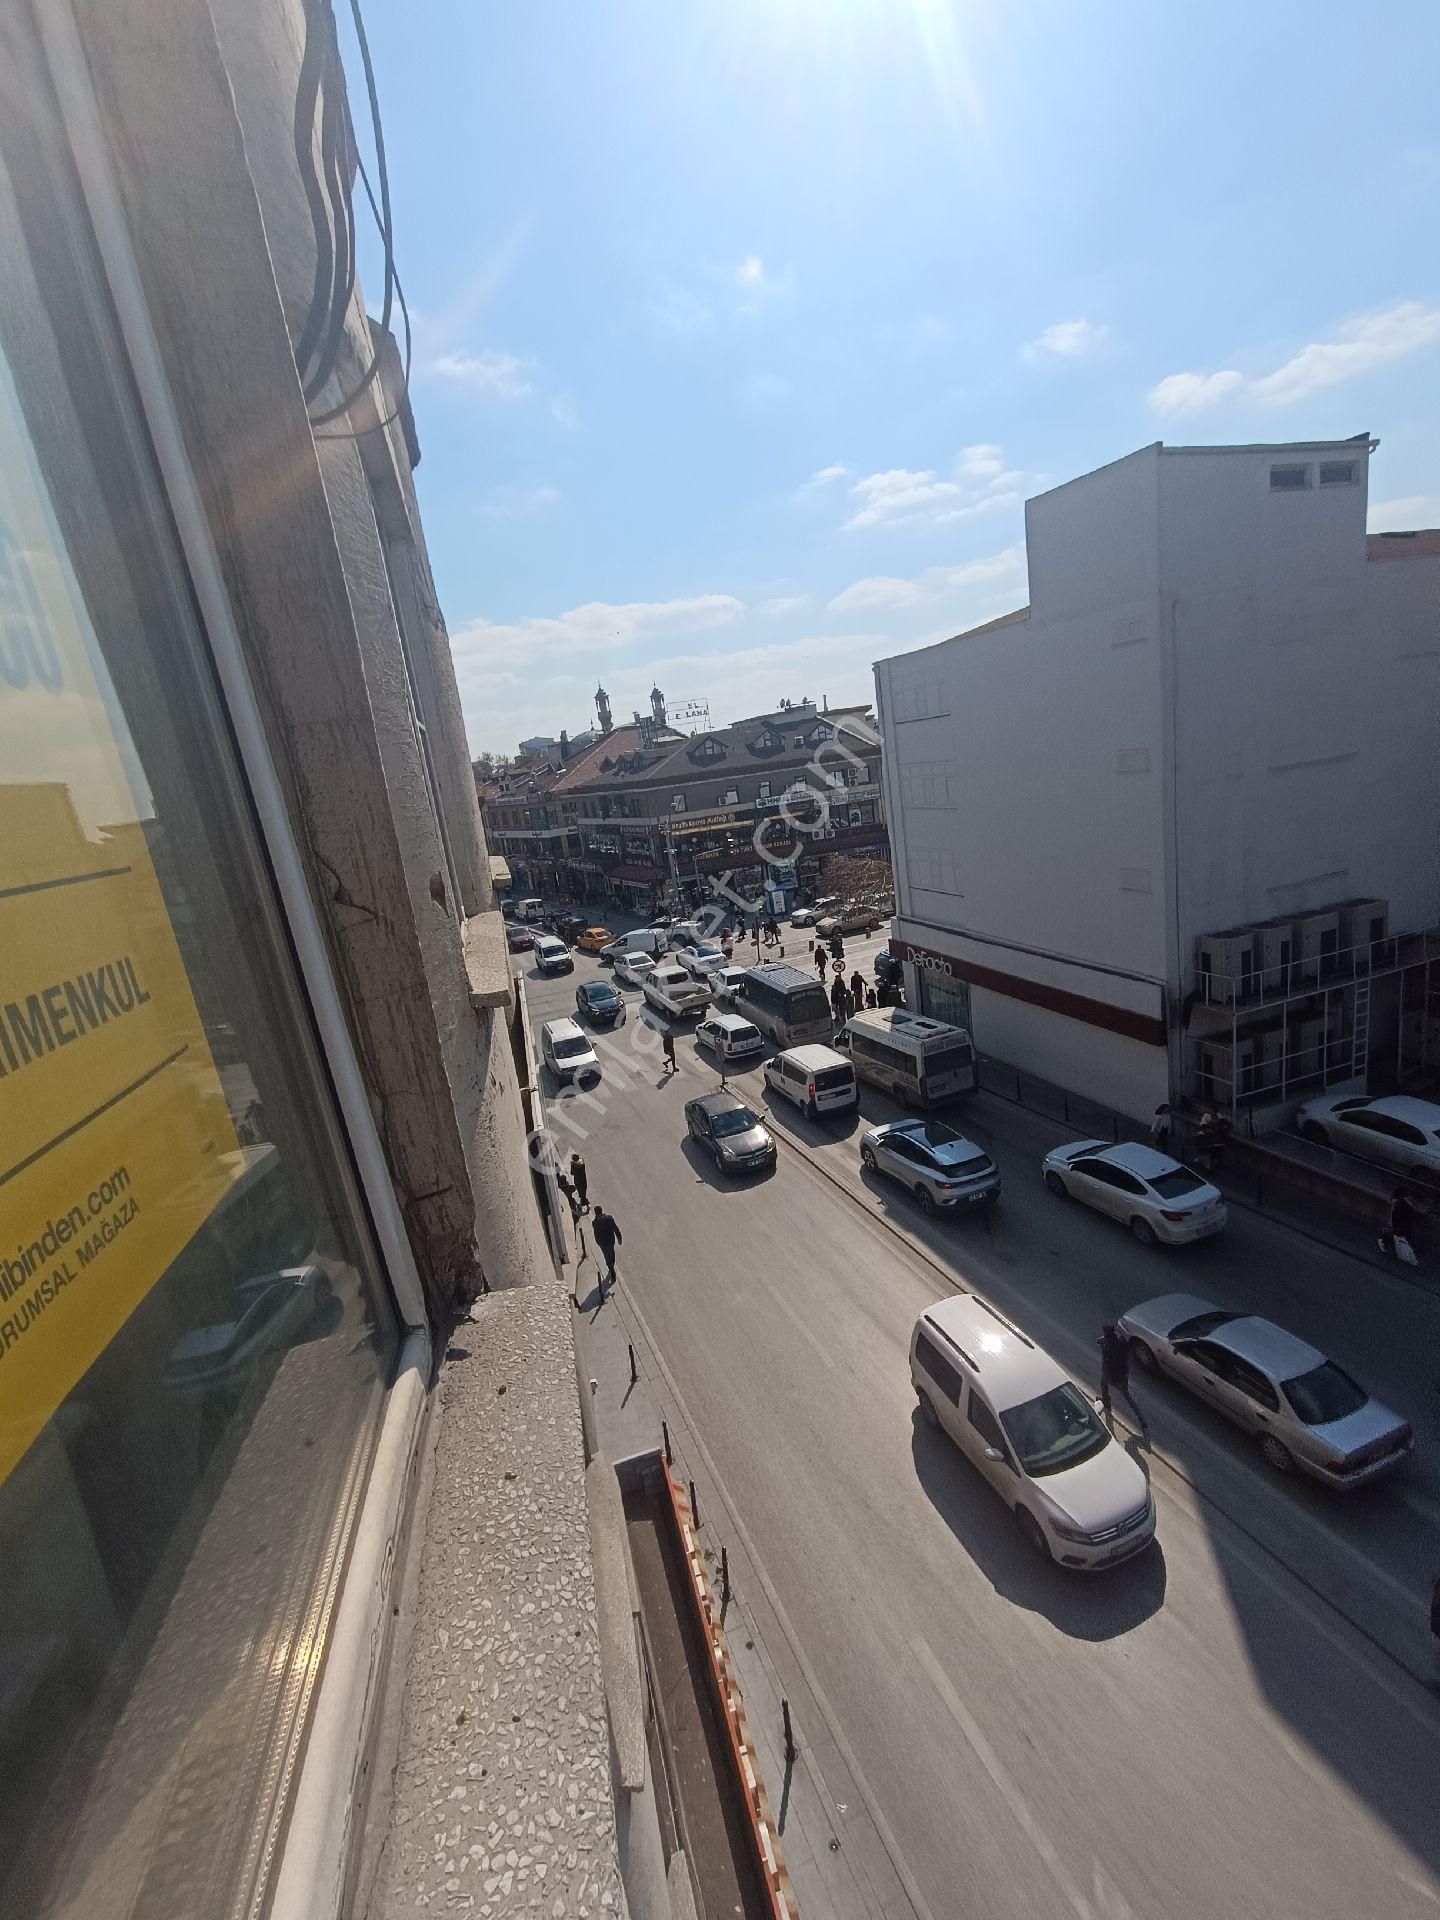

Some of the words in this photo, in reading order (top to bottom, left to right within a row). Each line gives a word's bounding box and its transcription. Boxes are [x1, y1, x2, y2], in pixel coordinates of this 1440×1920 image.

[0, 1166, 131, 1303] ibinden.com
[0, 1262, 78, 1359] RUMSAL
[76, 1197, 141, 1269] MAĞAZA
